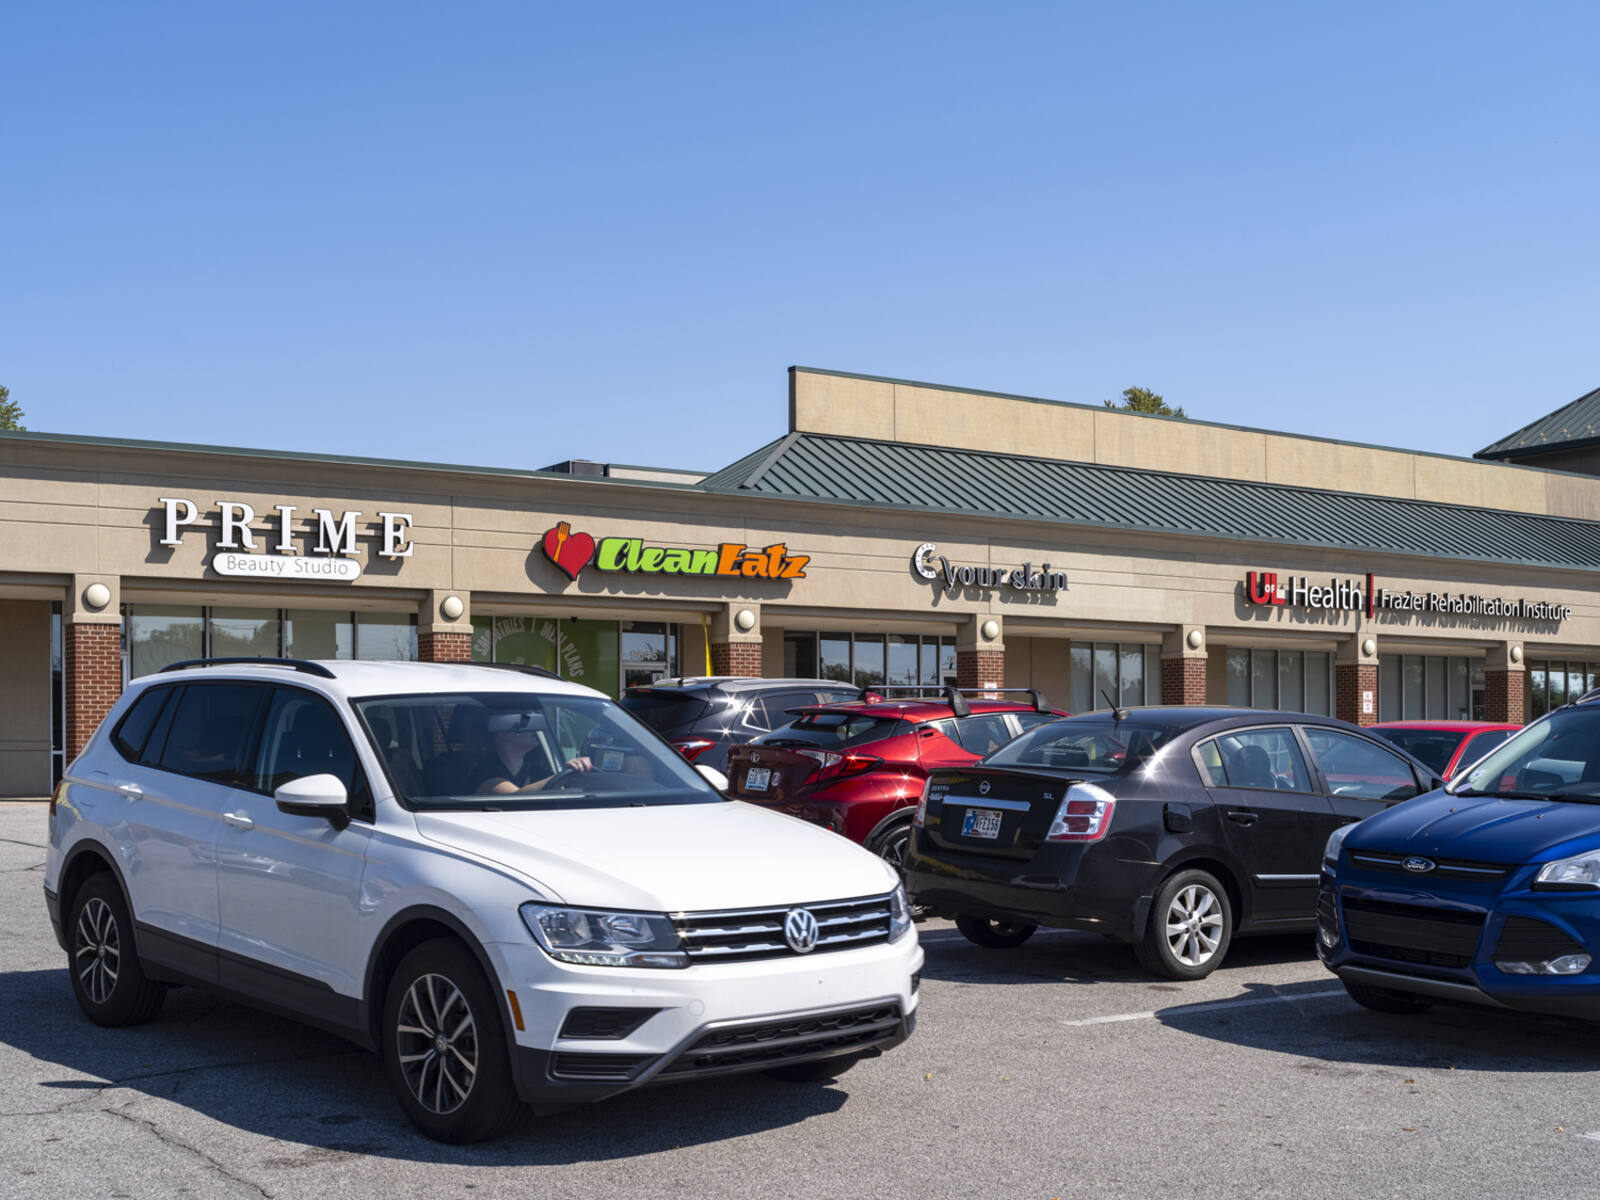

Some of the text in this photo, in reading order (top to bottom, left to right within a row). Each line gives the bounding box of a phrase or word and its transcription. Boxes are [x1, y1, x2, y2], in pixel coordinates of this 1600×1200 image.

[158, 497, 415, 558] PRIME
[226, 555, 349, 576] Beauty Studio
[926, 555, 1008, 592] your
[1010, 561, 1070, 593] skin
[1290, 575, 1362, 610] Health
[1379, 588, 1573, 621] Frazier Rehabilitation Institute
